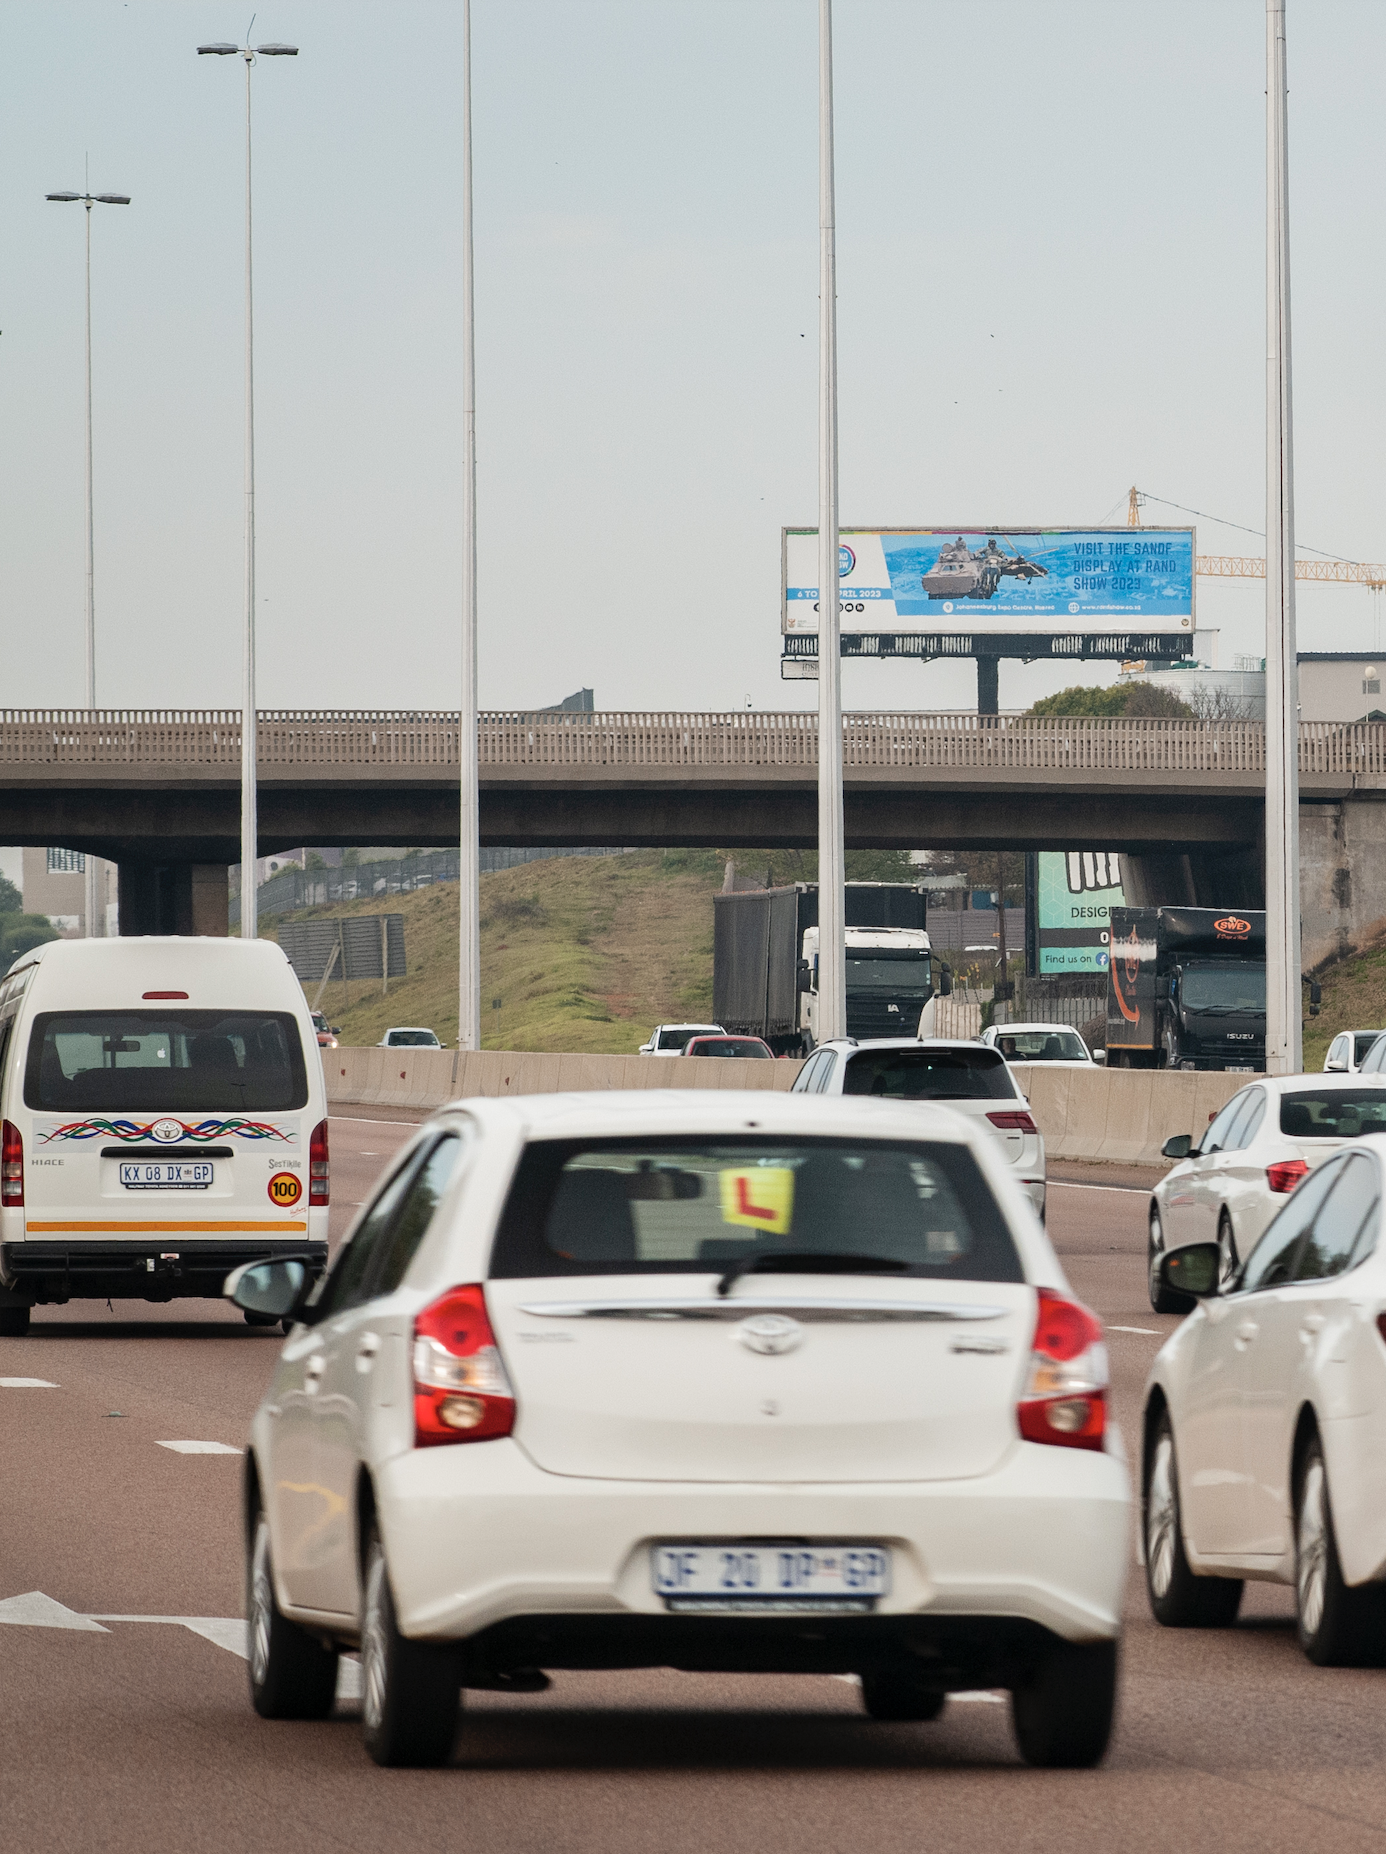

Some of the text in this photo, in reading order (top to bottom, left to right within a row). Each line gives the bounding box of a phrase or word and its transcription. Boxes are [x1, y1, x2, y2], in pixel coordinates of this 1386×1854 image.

[1074, 542, 1172, 555] VISIT THE SANDF
[1073, 560, 1176, 572] DISPLAY AT RAND
[1074, 577, 1141, 590] SHOW 2023
[797, 590, 881, 598] 6 TO PRIL 2023
[1220, 921, 1244, 930] SWE
[1046, 955, 1065, 963] Find
[1080, 955, 1092, 963] on
[124, 1166, 209, 1181] KX 08 DX GP
[273, 1182, 297, 1197] 100
[734, 1177, 779, 1221] L
[844, 1552, 885, 1588] GP
